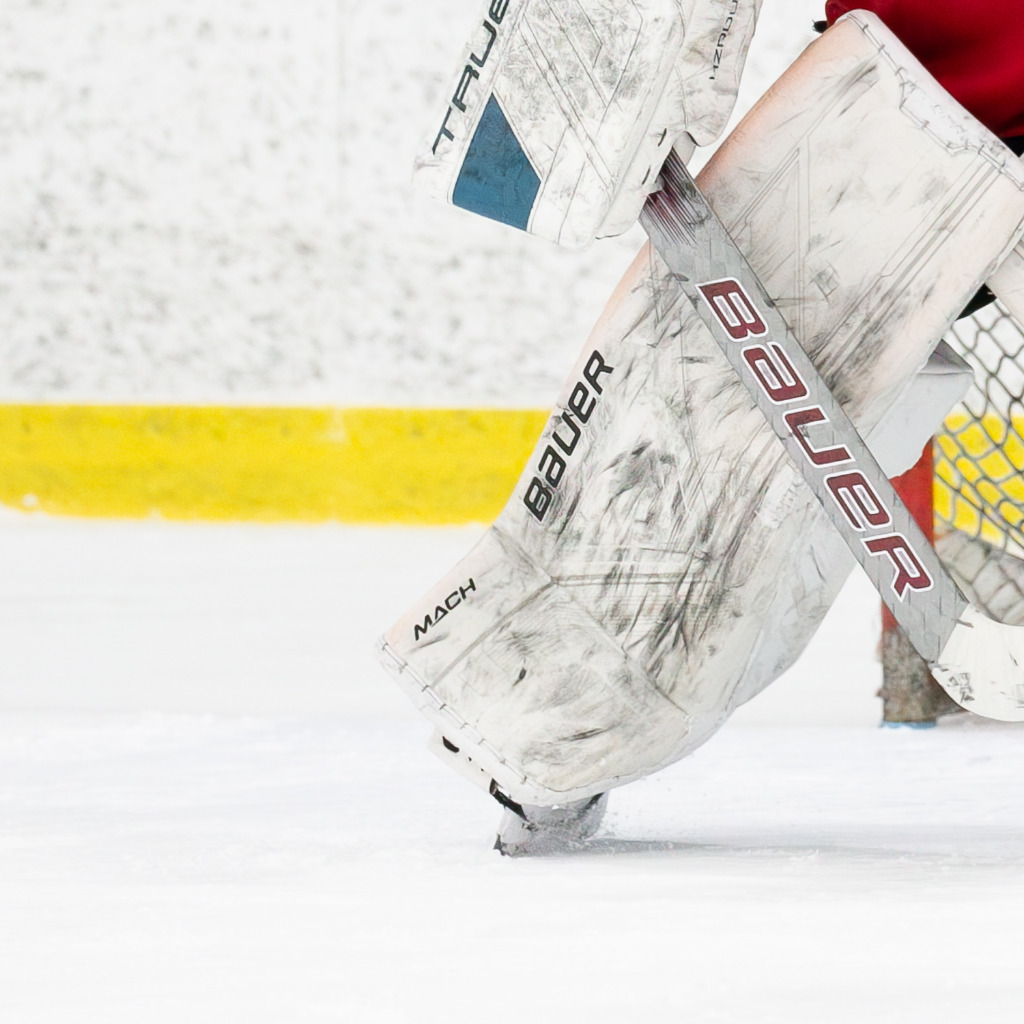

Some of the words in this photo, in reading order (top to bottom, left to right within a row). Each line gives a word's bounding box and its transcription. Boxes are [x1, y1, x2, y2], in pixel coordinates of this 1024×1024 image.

[522, 349, 615, 522] BAUER
[695, 277, 935, 603] BAUER
[413, 577, 477, 641] MACH
